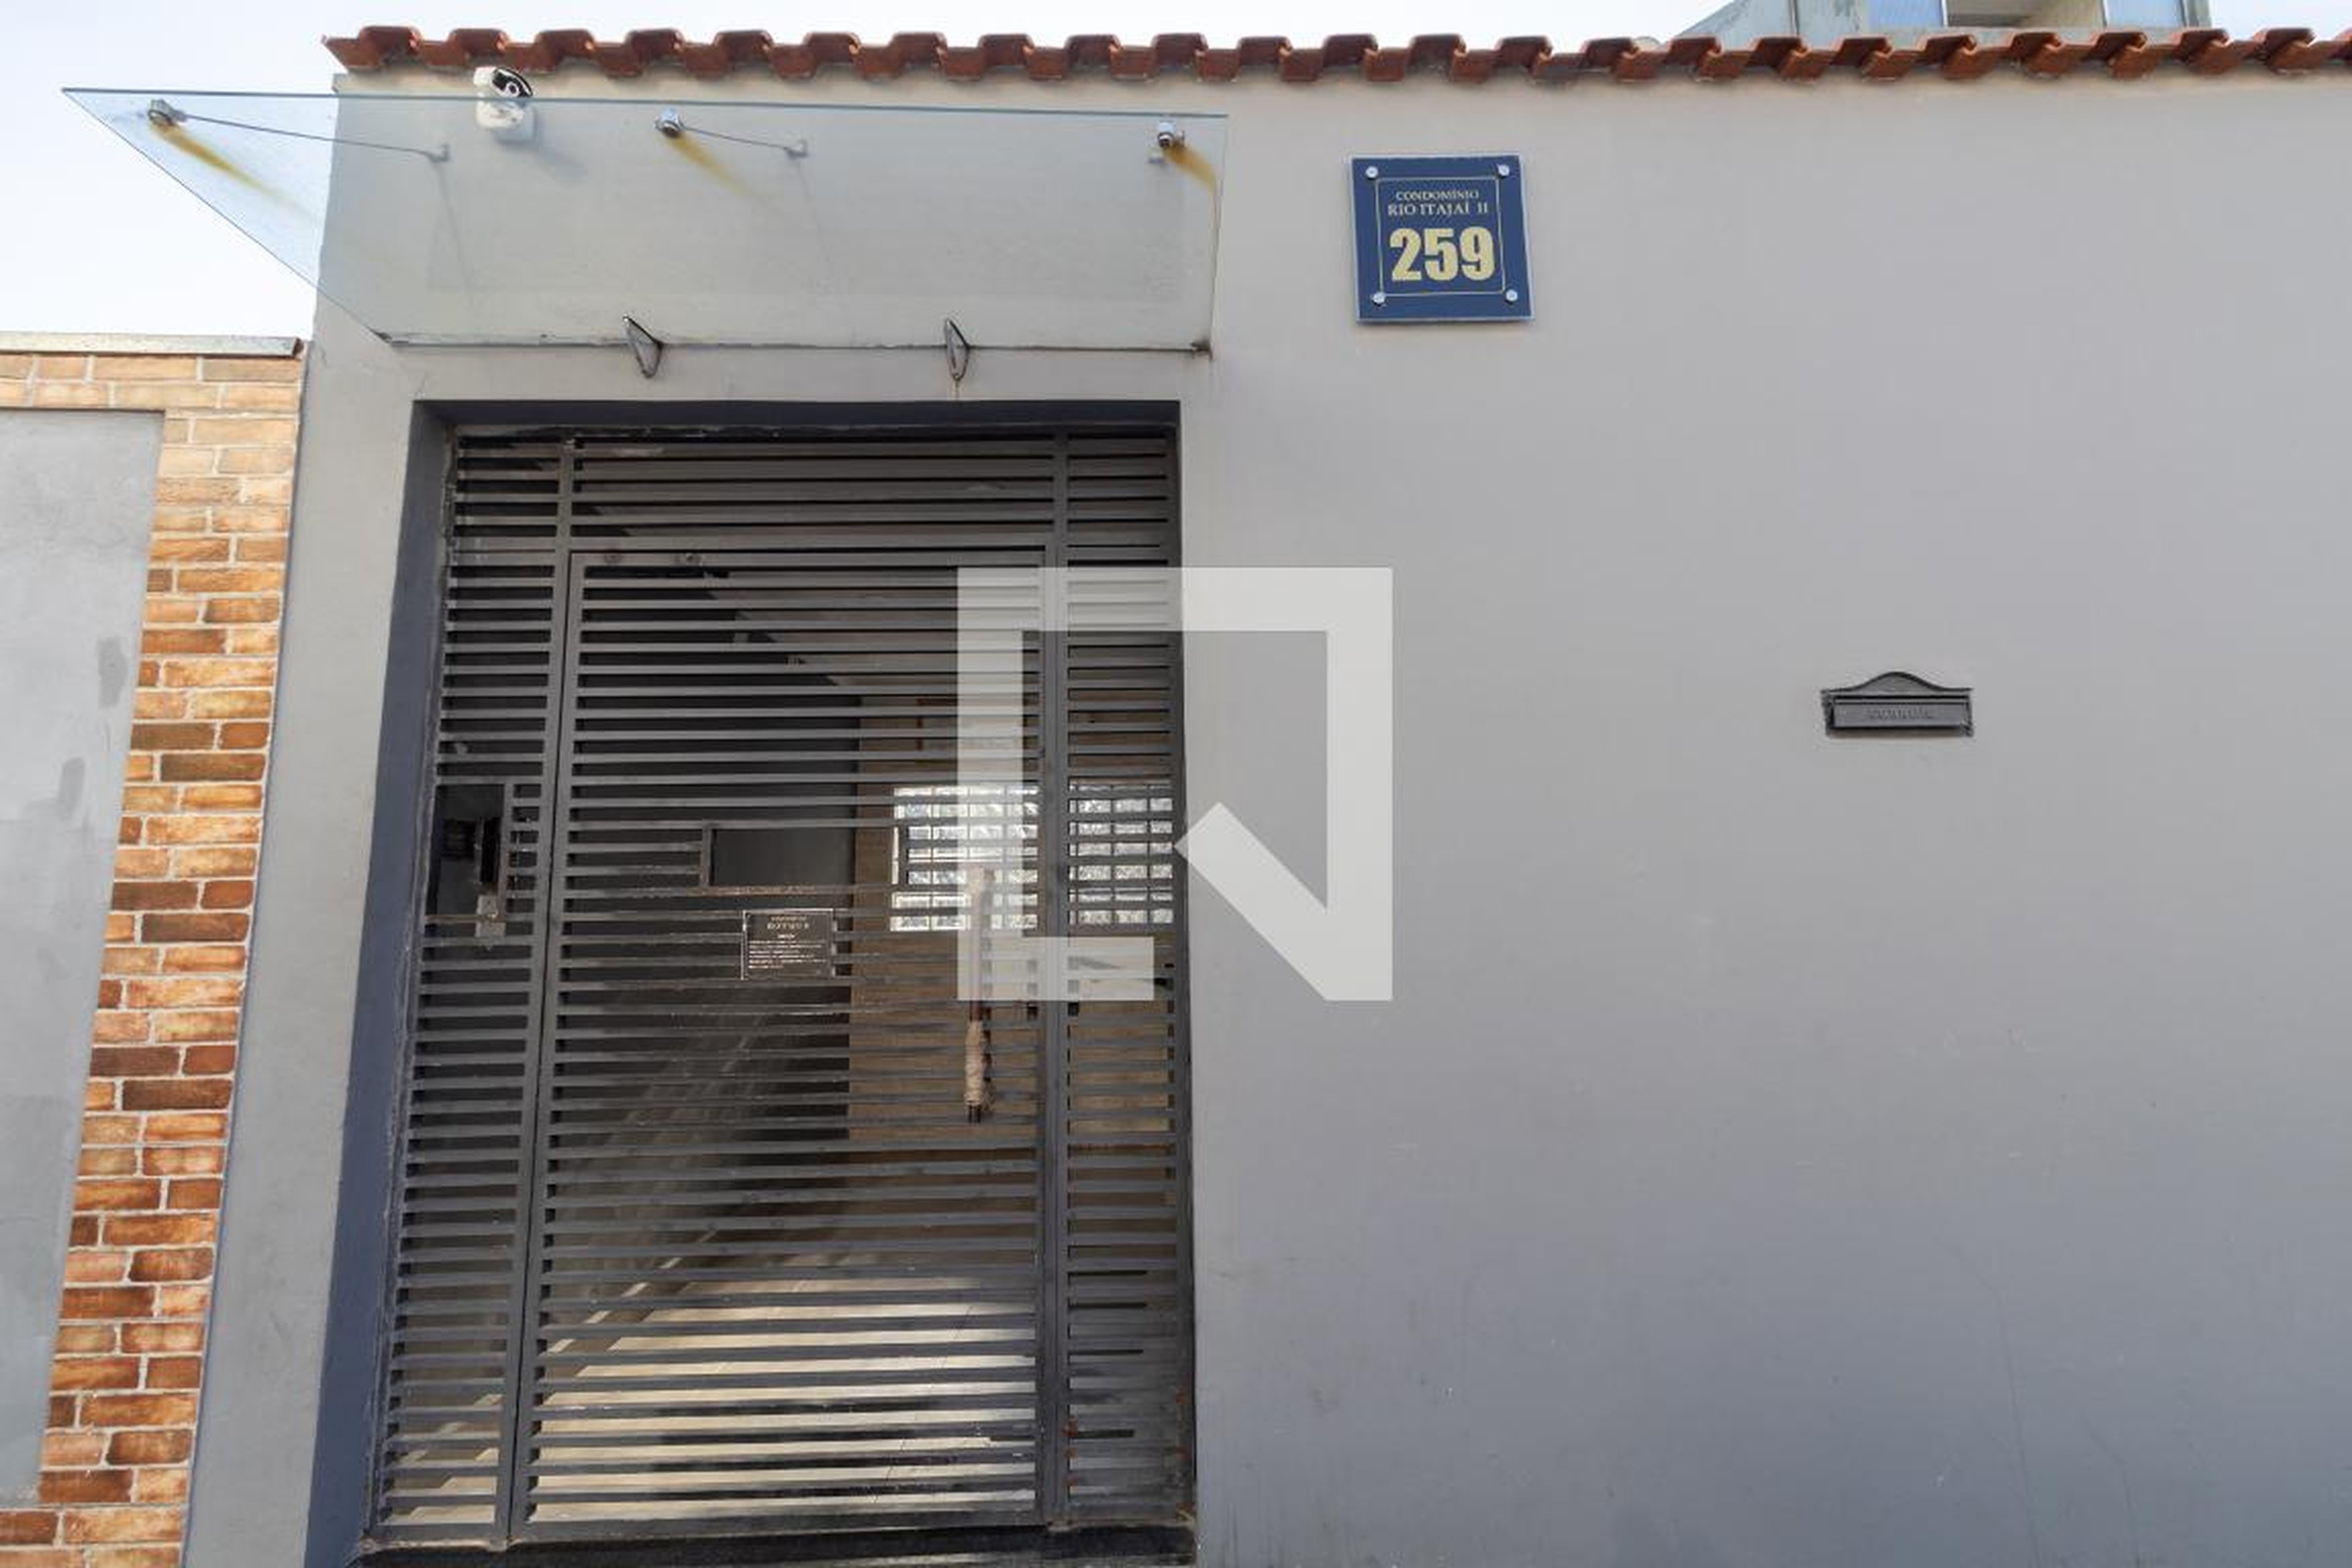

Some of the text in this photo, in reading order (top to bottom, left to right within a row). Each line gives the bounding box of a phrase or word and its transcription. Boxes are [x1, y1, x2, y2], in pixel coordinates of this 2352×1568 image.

[1388, 203, 1415, 216] RIO
[1477, 202, 1488, 213] II
[1390, 226, 1494, 281] 259
